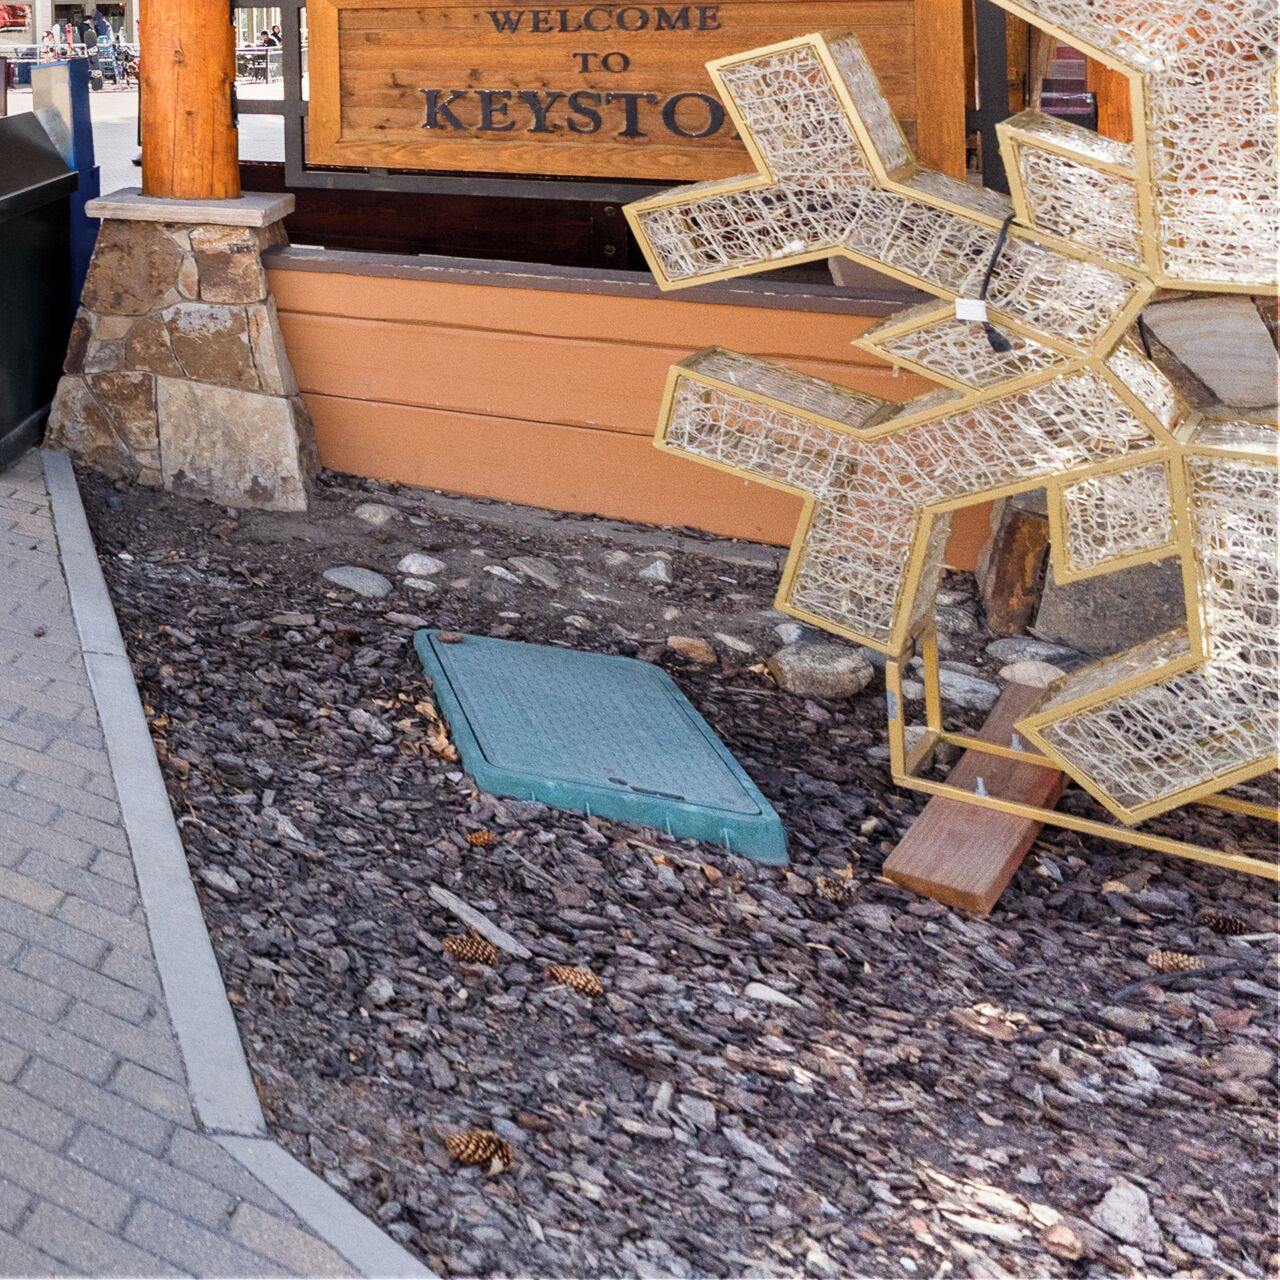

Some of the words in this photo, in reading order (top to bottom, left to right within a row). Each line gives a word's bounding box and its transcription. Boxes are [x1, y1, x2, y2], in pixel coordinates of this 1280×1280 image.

[488, 4, 721, 33] WELCOME
[572, 51, 631, 73] TO
[418, 86, 740, 139] KEYSTO
